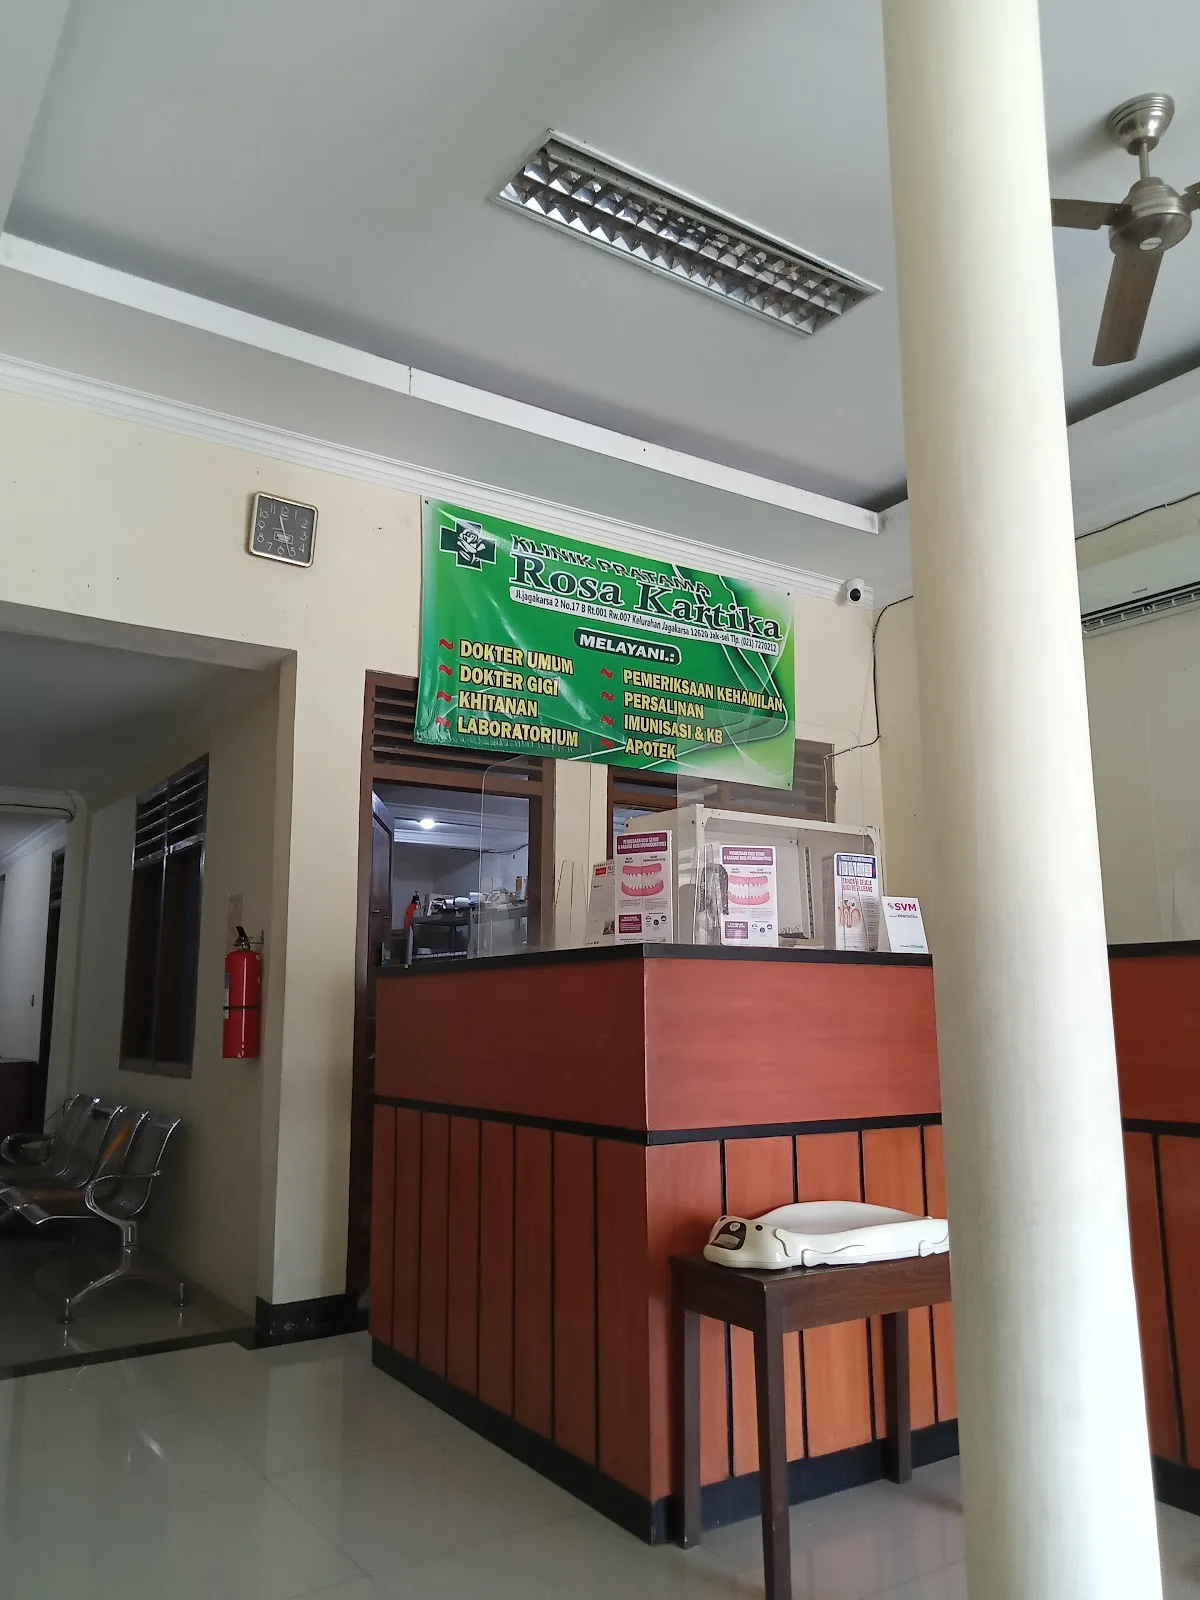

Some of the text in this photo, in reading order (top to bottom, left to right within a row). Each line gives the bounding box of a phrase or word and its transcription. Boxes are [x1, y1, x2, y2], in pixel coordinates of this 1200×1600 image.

[258, 520, 266, 530] 9
[259, 508, 269, 518] 10
[300, 518, 308, 529] 2
[257, 532, 264, 543] 8
[267, 542, 272, 552] 7
[300, 530, 306, 541] 3
[277, 545, 284, 555] 6
[511, 534, 711, 596] KLINIK PRATAMA
[509, 552, 783, 640] Rosa Kartika
[554, 598, 559, 608] 2
[560, 601, 580, 612] No.17
[582, 604, 586, 612] B
[588, 605, 607, 618] Rt.001
[609, 610, 630, 622] Rw.007
[632, 616, 660, 630] Kelurahan
[662, 620, 690, 636] Jagakarsa
[691, 628, 708, 638] 12620
[710, 631, 730, 642] Jak-sel
[741, 637, 754, 649] (021)
[460, 639, 574, 675] DOKTER UMUM
[459, 664, 559, 696] DOKTER GIGI
[623, 668, 782, 712] PEMERIKSAAN KEHAMILAN
[458, 690, 538, 718] KHITANAN
[624, 691, 704, 720] PERSALINAN
[457, 716, 579, 748] LABORATORIUM
[624, 714, 723, 744] IMUNISASI & KB
[625, 737, 676, 760] APOTEK
[894, 902, 916, 912] SVM
